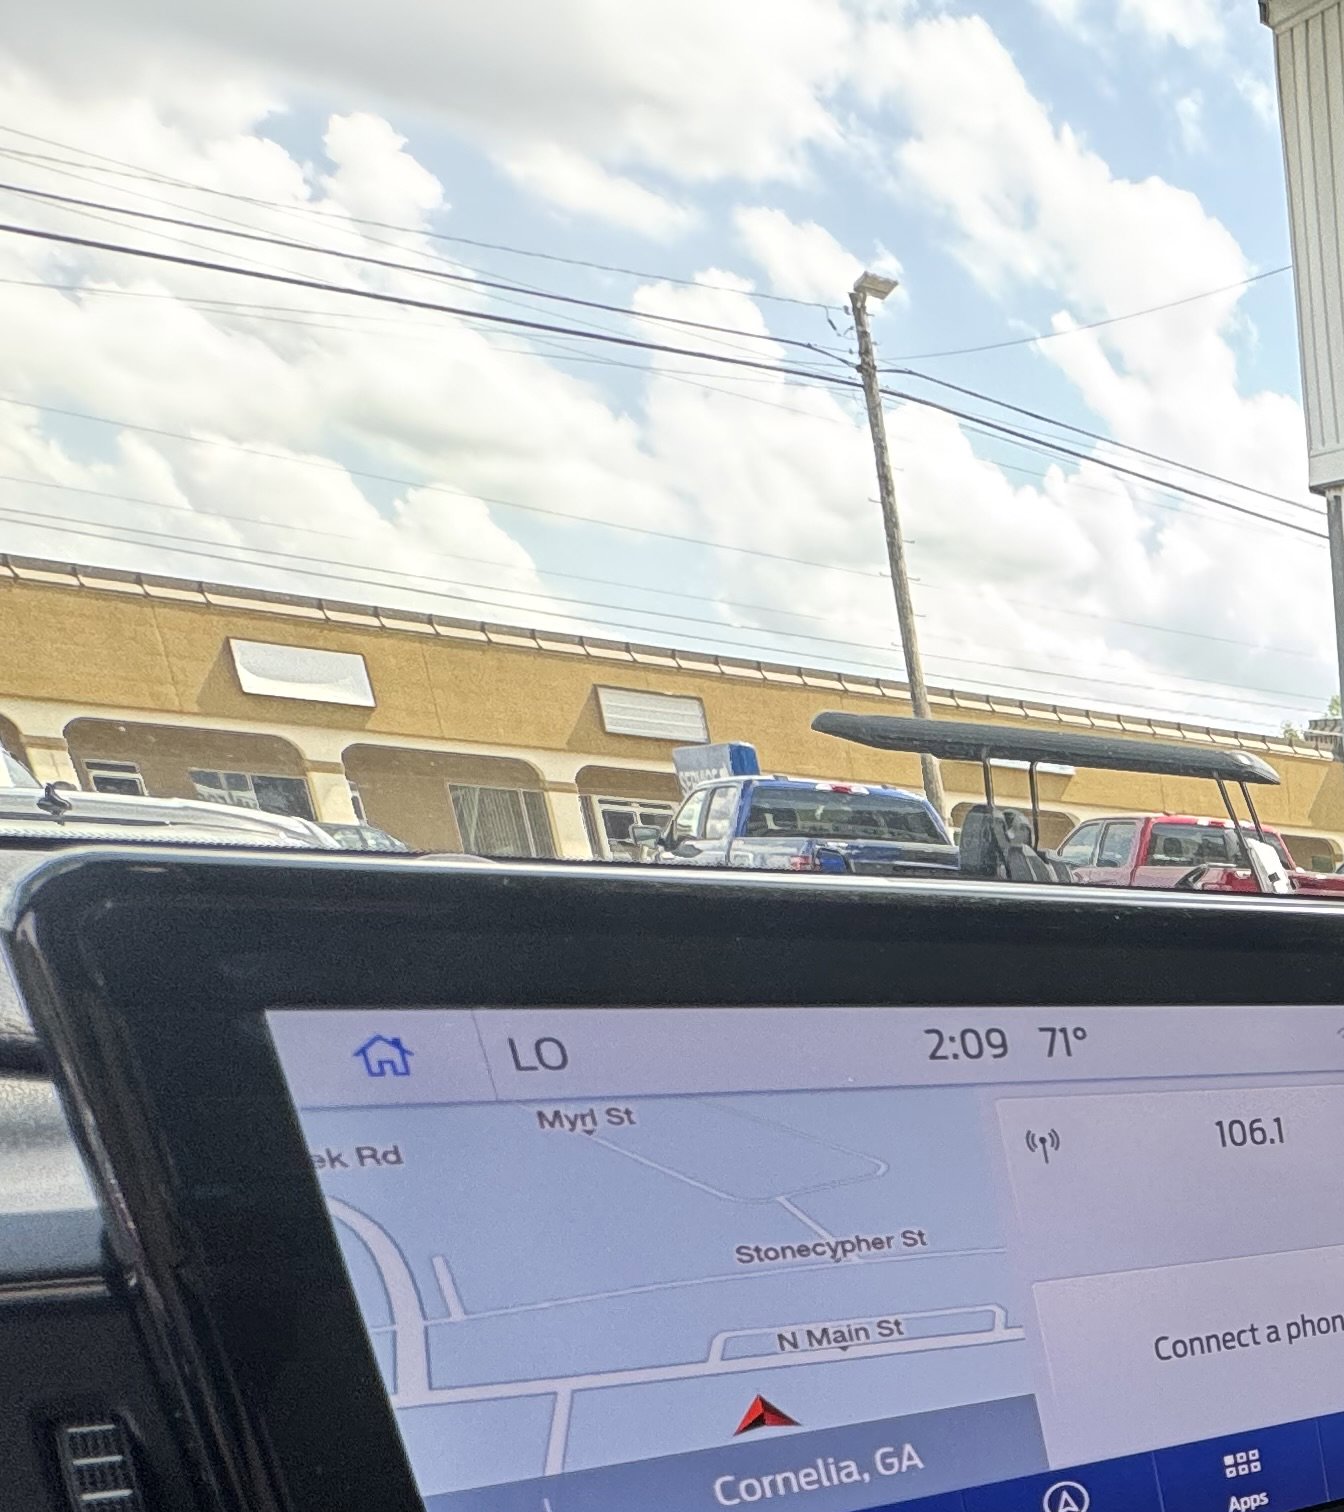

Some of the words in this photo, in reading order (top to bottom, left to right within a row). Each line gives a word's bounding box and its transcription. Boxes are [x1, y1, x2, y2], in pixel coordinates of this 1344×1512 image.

[508, 1035, 569, 1072] LO
[924, 1028, 1009, 1061] 2:09
[537, 1107, 597, 1132] Myrl
[606, 1107, 636, 1126] St
[1215, 1117, 1285, 1149] 106.1
[355, 1145, 403, 1166] Rd
[735, 1232, 894, 1264] Stonecypher
[901, 1230, 927, 1249] St
[777, 1331, 800, 1351] N
[806, 1323, 868, 1348] Main
[876, 1319, 903, 1340] St
[1154, 1323, 1260, 1361] Connect
[1266, 1323, 1281, 1343] a
[714, 1457, 870, 1506] Cornelia,
[875, 1444, 923, 1477] GA
[1228, 1490, 1269, 1512] Apps
